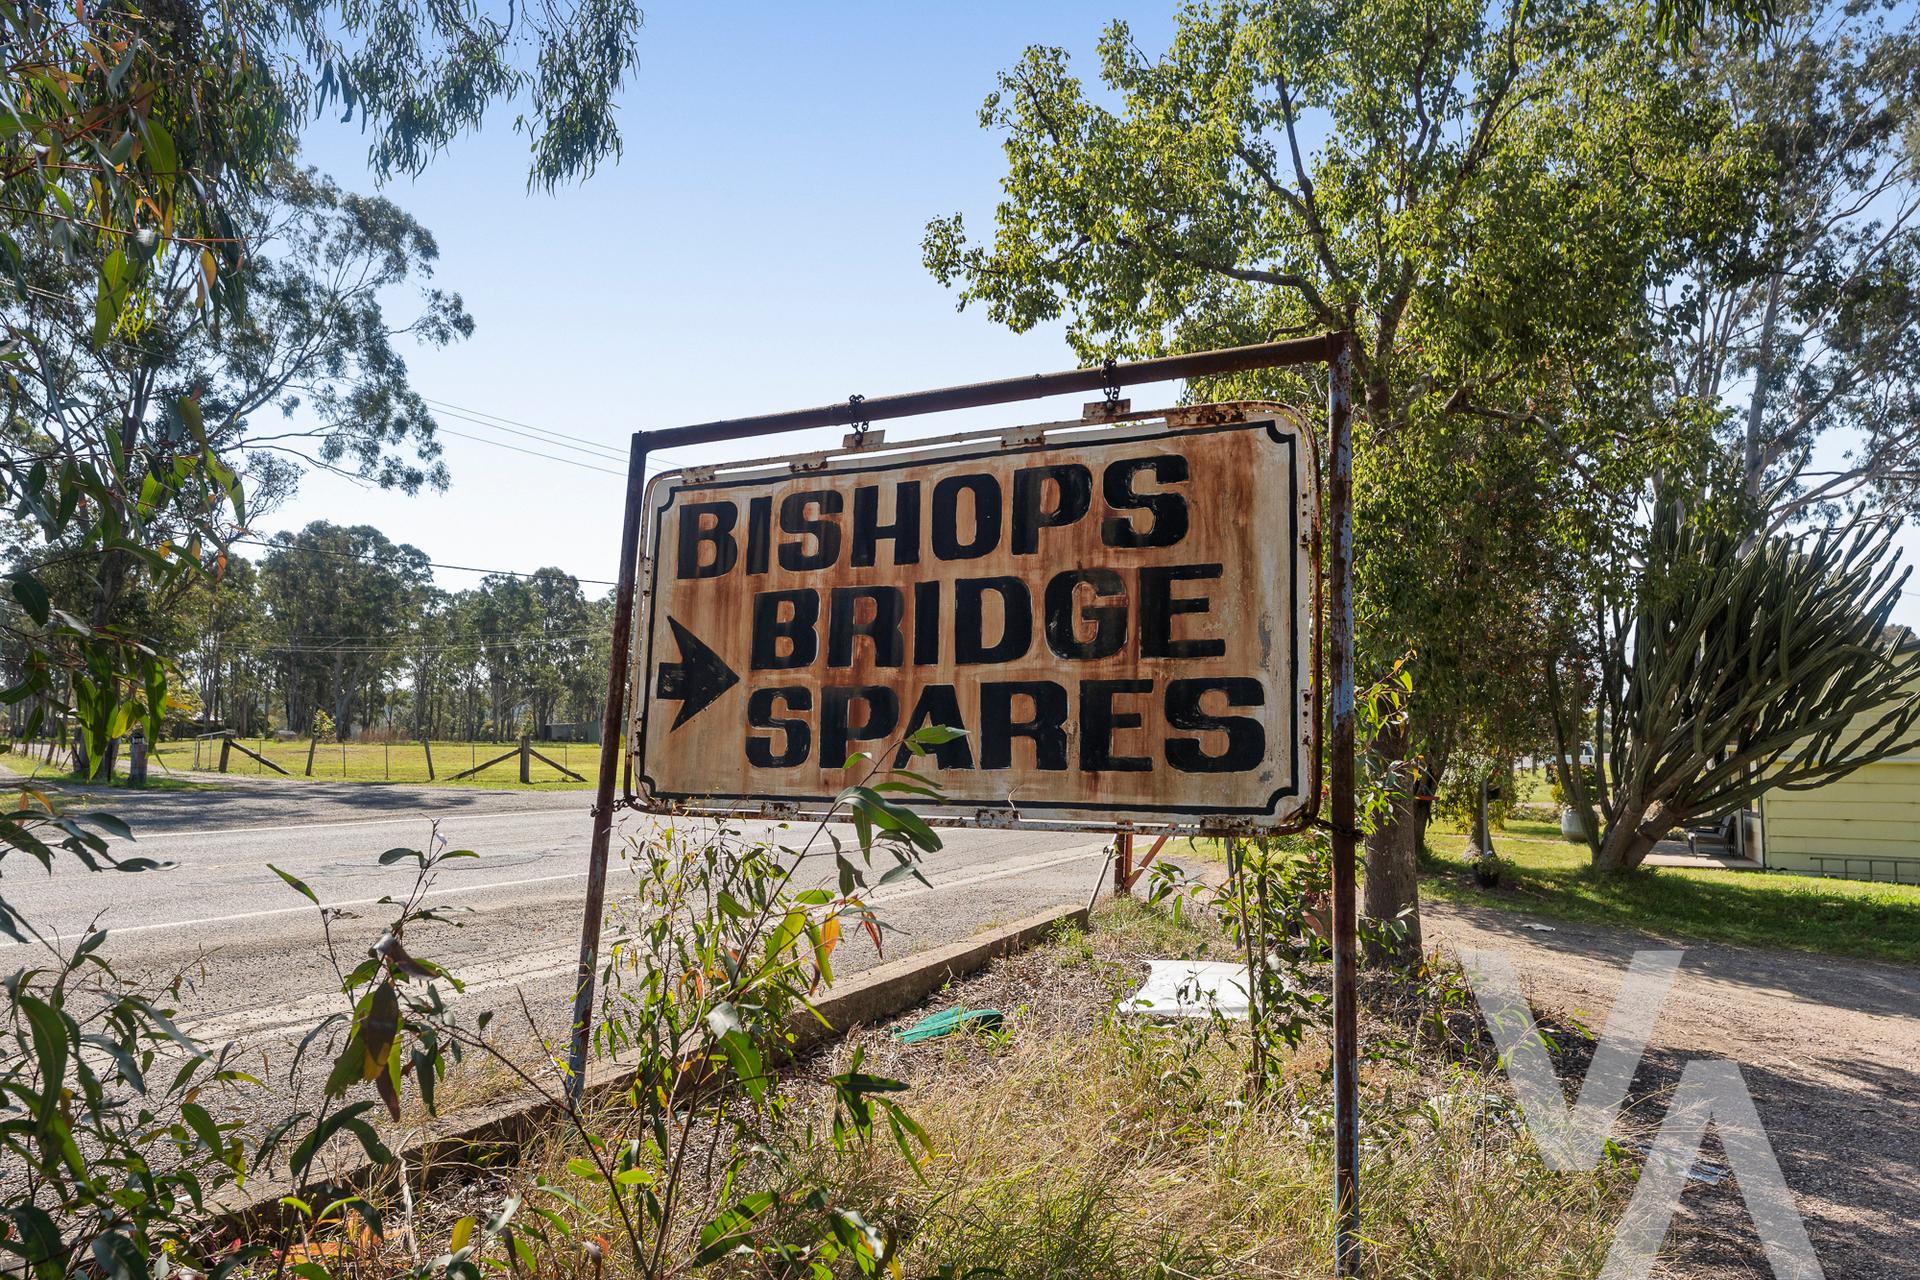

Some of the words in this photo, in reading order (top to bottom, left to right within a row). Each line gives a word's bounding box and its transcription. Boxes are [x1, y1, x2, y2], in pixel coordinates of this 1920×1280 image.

[677, 455, 1190, 579] BISHOPS
[751, 564, 1226, 670] BRIDGE
[745, 677, 1266, 774] SPARES
